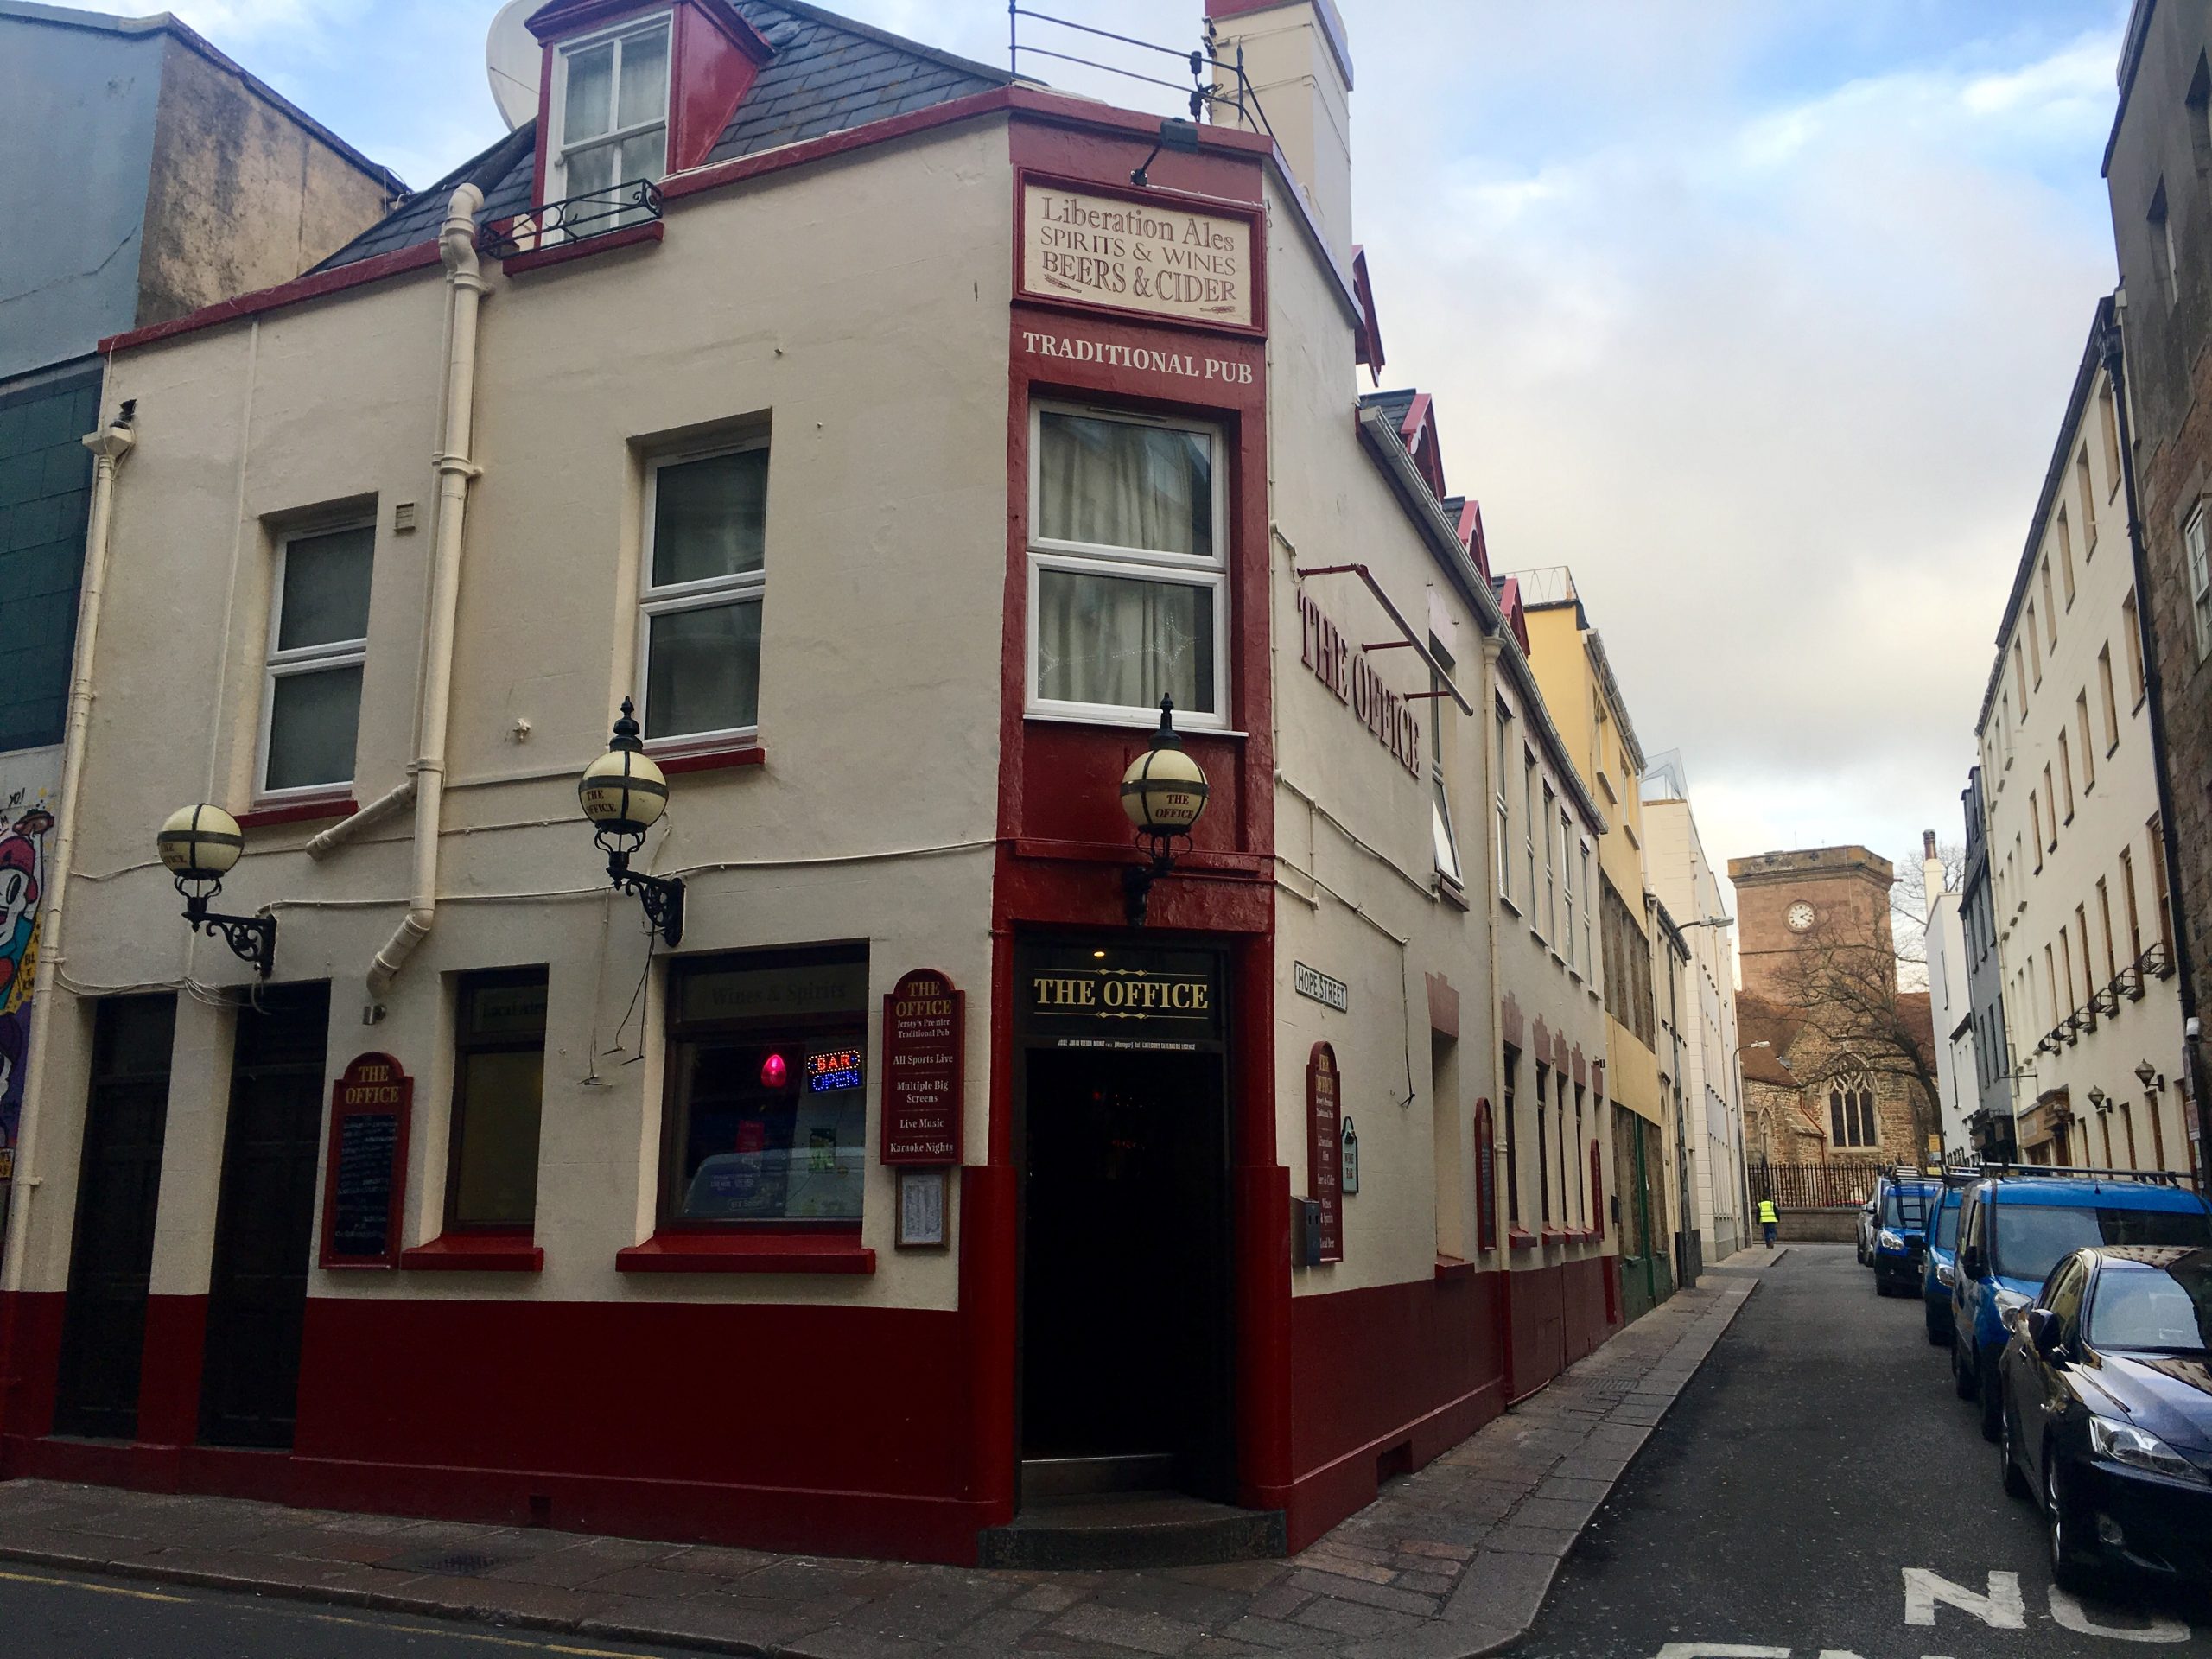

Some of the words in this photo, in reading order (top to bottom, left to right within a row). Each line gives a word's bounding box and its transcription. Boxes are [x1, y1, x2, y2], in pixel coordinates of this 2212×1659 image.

[1041, 196, 1174, 242] Liberation
[1182, 218, 1235, 252] Ales
[1040, 226, 1126, 257] SPIRITS
[1133, 242, 1152, 263] &
[1161, 246, 1236, 276] WINES
[1042, 251, 1127, 294] BEERS
[1133, 266, 1153, 299] &
[1155, 270, 1237, 302] CIDER
[1022, 331, 1199, 378] TRADITIONAL
[1205, 358, 1253, 385] PUB
[1297, 586, 1349, 706] THE
[1352, 653, 1421, 781] OFFICE
[587, 789, 605, 802] THE
[1166, 794, 1189, 805] THE
[1155, 808, 1193, 819] OFFICE
[907, 981, 940, 997] THE
[1033, 978, 1096, 1006] THE
[1103, 980, 1209, 1009] OFFICE
[1298, 967, 1318, 997] HOPE
[1319, 975, 1345, 1007] STREET
[895, 1000, 952, 1018] OFFICE
[899, 1029, 935, 1038] Traditional
[937, 1028, 950, 1037] Pub
[817, 1054, 850, 1071] BAR
[893, 1055, 906, 1065] All
[907, 1054, 934, 1066] Sports
[936, 1053, 954, 1064] Live
[359, 1065, 390, 1083] THE
[812, 1071, 858, 1090] OPEN
[897, 1080, 932, 1092] Multiple
[934, 1080, 949, 1091] Big
[346, 1086, 400, 1105] OFFICE
[906, 1094, 938, 1103] Screens
[899, 1119, 918, 1128] Live
[918, 1118, 944, 1128] Music
[890, 1142, 925, 1153] Karaoke
[925, 1141, 954, 1154] Nights
